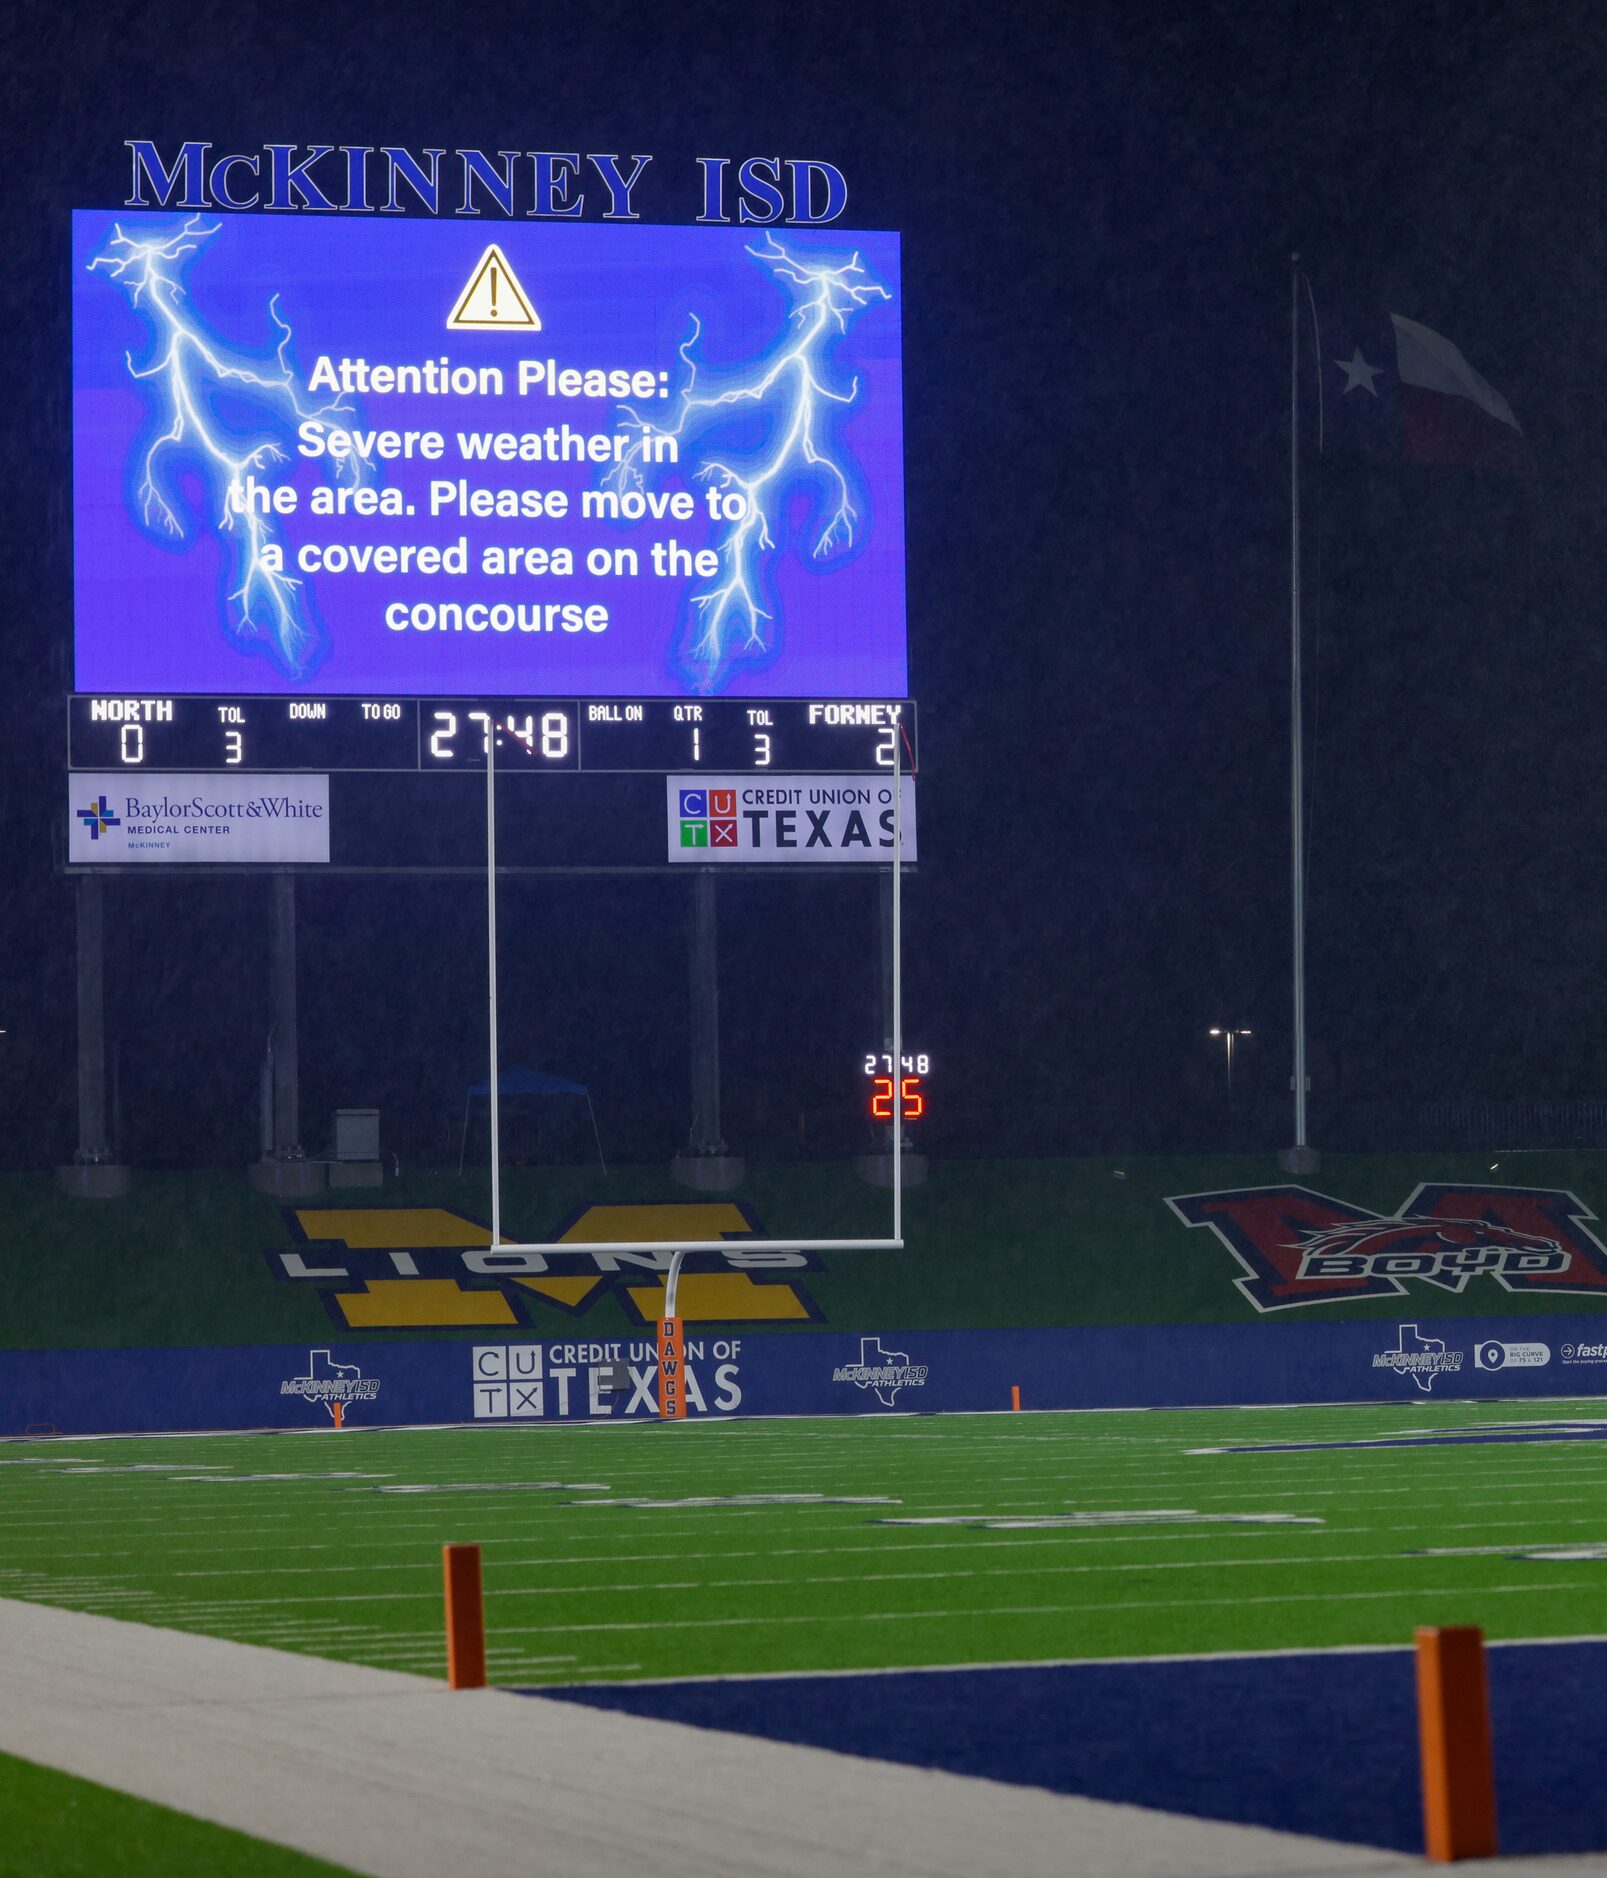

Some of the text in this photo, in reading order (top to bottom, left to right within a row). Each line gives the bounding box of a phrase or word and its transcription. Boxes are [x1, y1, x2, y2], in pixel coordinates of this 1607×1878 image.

[124, 140, 848, 224] McKINNEY ISD
[308, 356, 669, 398] Attention Please:
[297, 420, 679, 463] Severe weather in
[228, 475, 748, 521] the area. Please move to
[259, 537, 719, 577] a covered area on the
[385, 602, 609, 633] concourse
[91, 699, 173, 721] NORTH
[218, 706, 245, 724] TOL
[289, 703, 327, 720] DOWN
[361, 703, 401, 720] TO GO
[588, 705, 643, 722] BALL ON
[673, 705, 703, 722] QTR
[747, 709, 774, 727] TOL
[808, 704, 902, 726] FORNEY
[121, 724, 144, 764] 0
[225, 731, 242, 764] 3
[430, 712, 568, 758] 27:48
[693, 728, 700, 762] 1
[754, 734, 770, 766] 3
[875, 728, 895, 766] 2
[742, 789, 803, 805] CREDIT
[809, 789, 871, 805] UNION
[127, 826, 230, 834] MEDICAL CENTER
[742, 810, 903, 848] TEXAS
[872, 1079, 922, 1116] 25
[278, 1249, 808, 1278] LIONS
[1295, 1246, 1573, 1280] BOYD
[549, 1343, 621, 1364] CREDIT
[712, 1340, 742, 1360] OF
[661, 1321, 679, 1416] DAWGS
[871, 1379, 925, 1388] ATHLETICS
[1409, 1364, 1461, 1373] ATHLETICS
[320, 1392, 377, 1401] ATHLETICS
